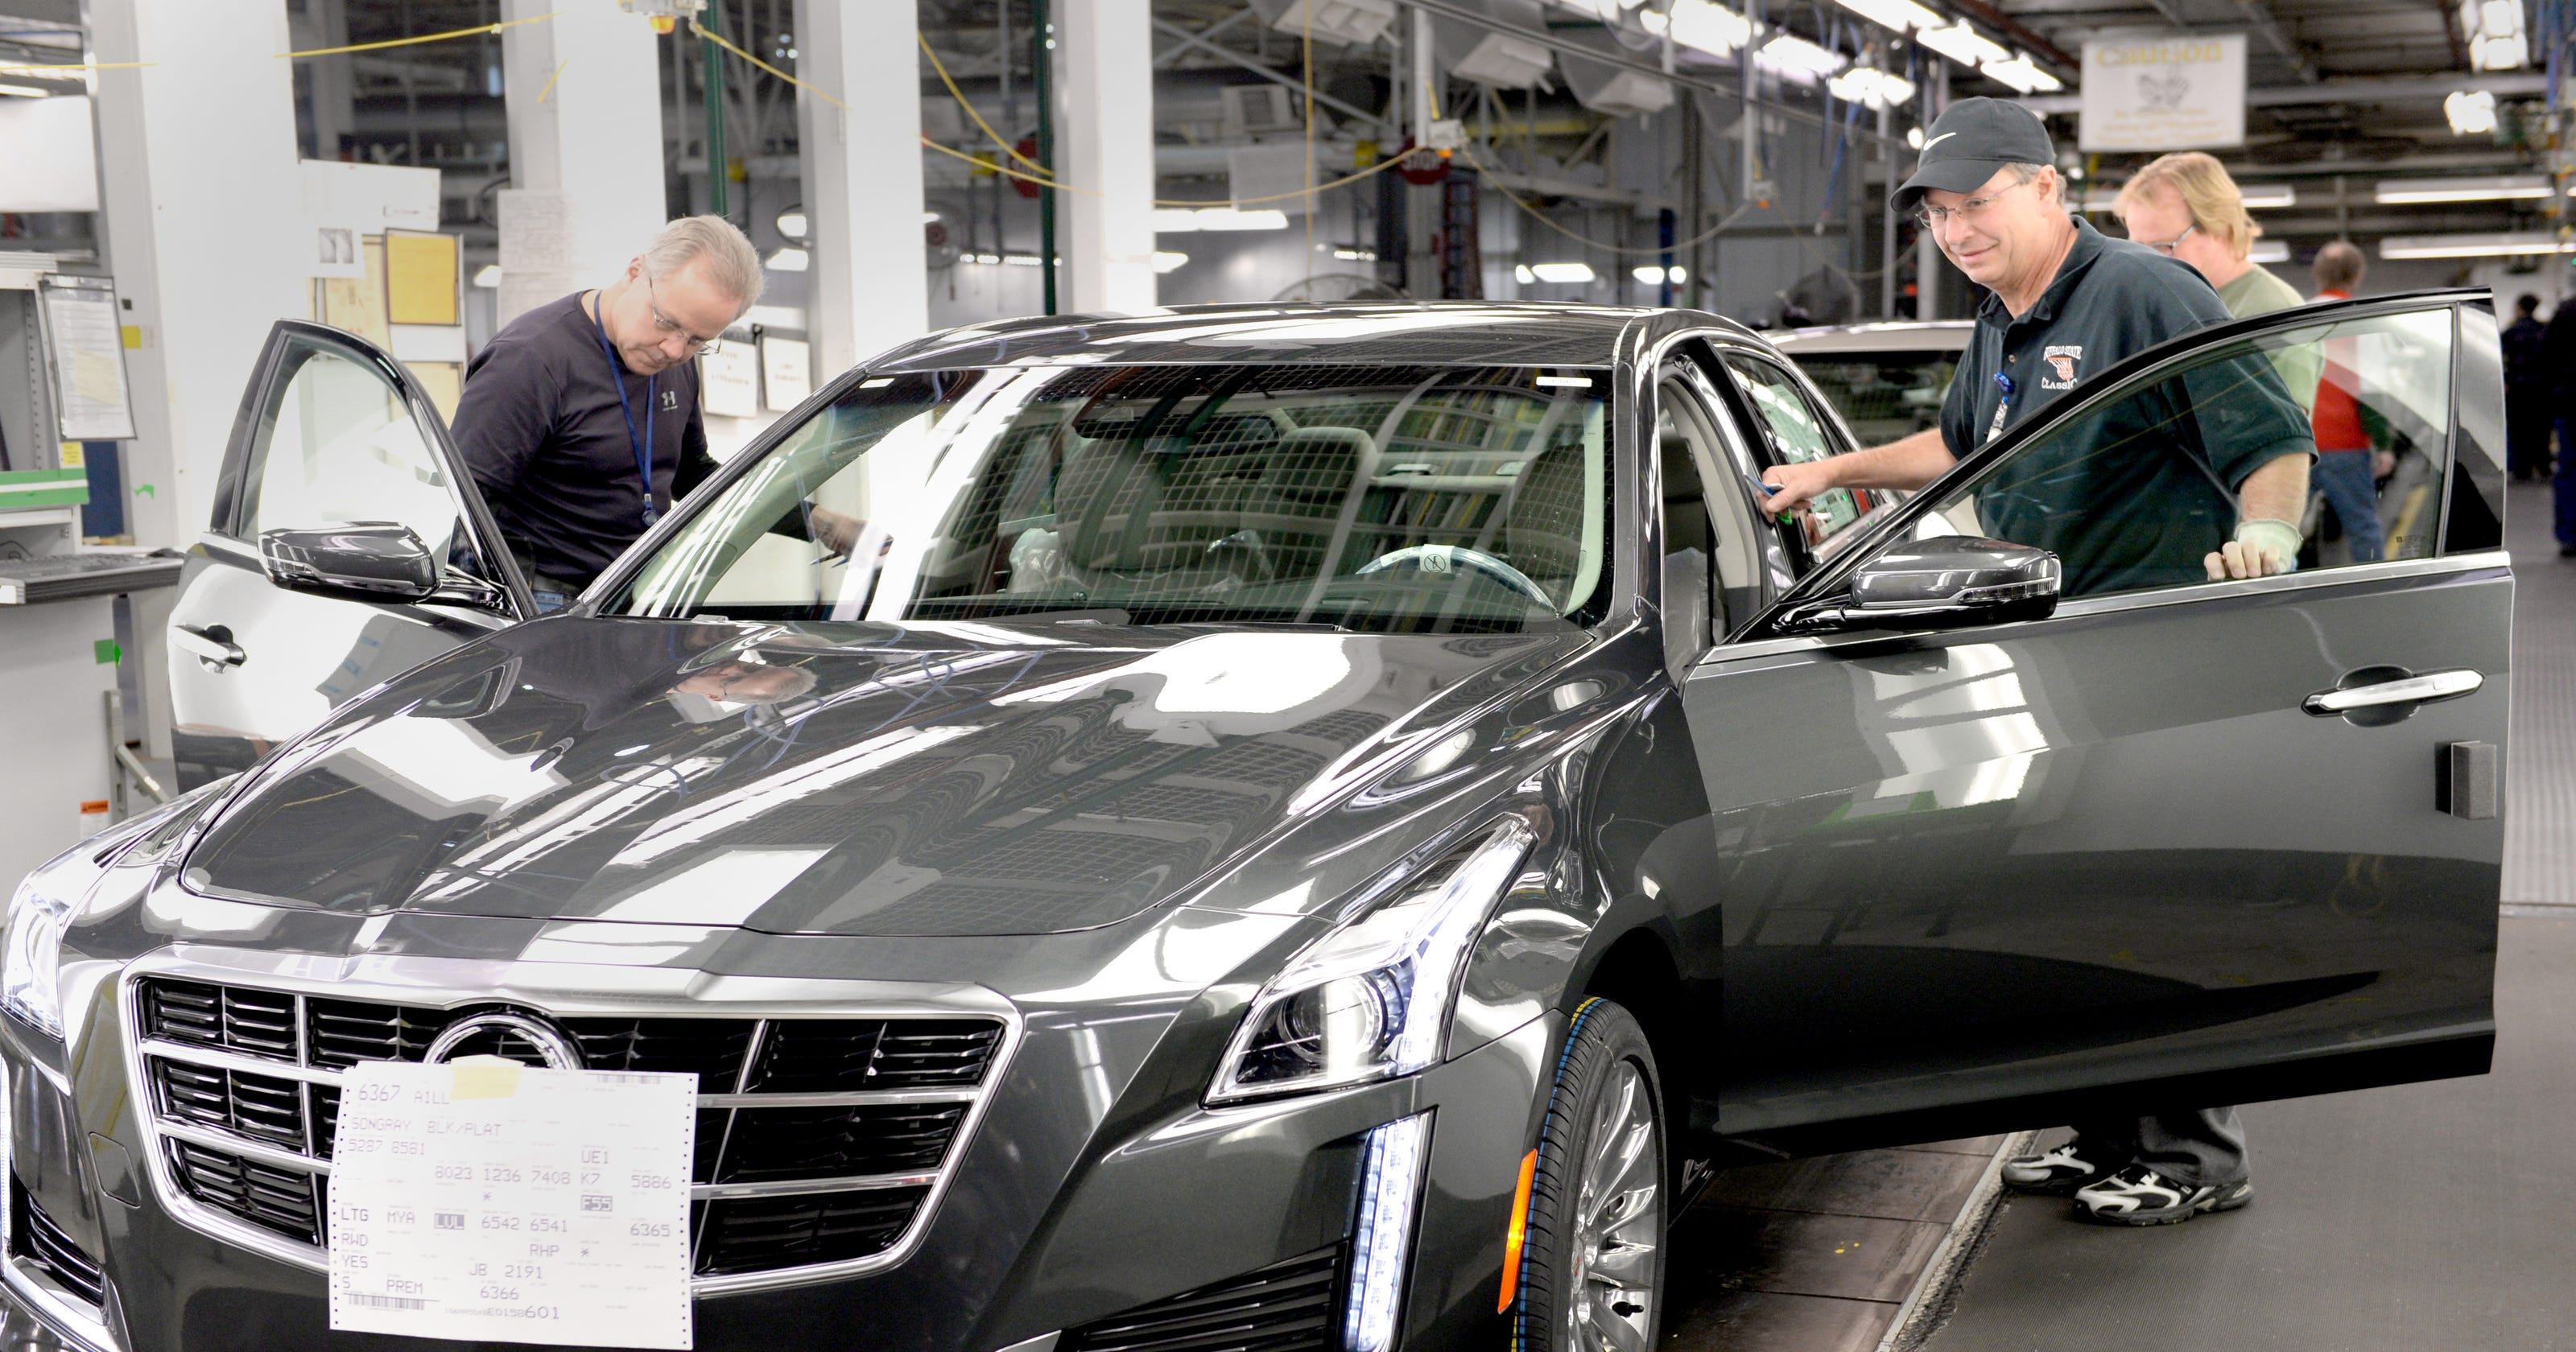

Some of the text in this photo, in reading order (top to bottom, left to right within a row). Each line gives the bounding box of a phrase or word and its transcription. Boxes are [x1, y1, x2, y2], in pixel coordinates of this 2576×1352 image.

[357, 1083, 402, 1102] 6367
[426, 1120, 503, 1137] BLK/PLAT
[347, 1139, 426, 1156] 5287 8581
[580, 1150, 610, 1164] UE1
[433, 1164, 672, 1189] 8023 1236 7408 K7 5886
[341, 1208, 369, 1222] LTG
[386, 1210, 416, 1225] MYA
[481, 1216, 521, 1231] 6542
[530, 1218, 568, 1233] 6541
[630, 1222, 671, 1238] 6365
[341, 1233, 369, 1247] RWD
[529, 1244, 560, 1258] RHP
[341, 1255, 369, 1269] YES
[468, 1263, 543, 1280] JB 2191
[386, 1279, 423, 1295] PREM
[480, 1286, 520, 1301] 6366
